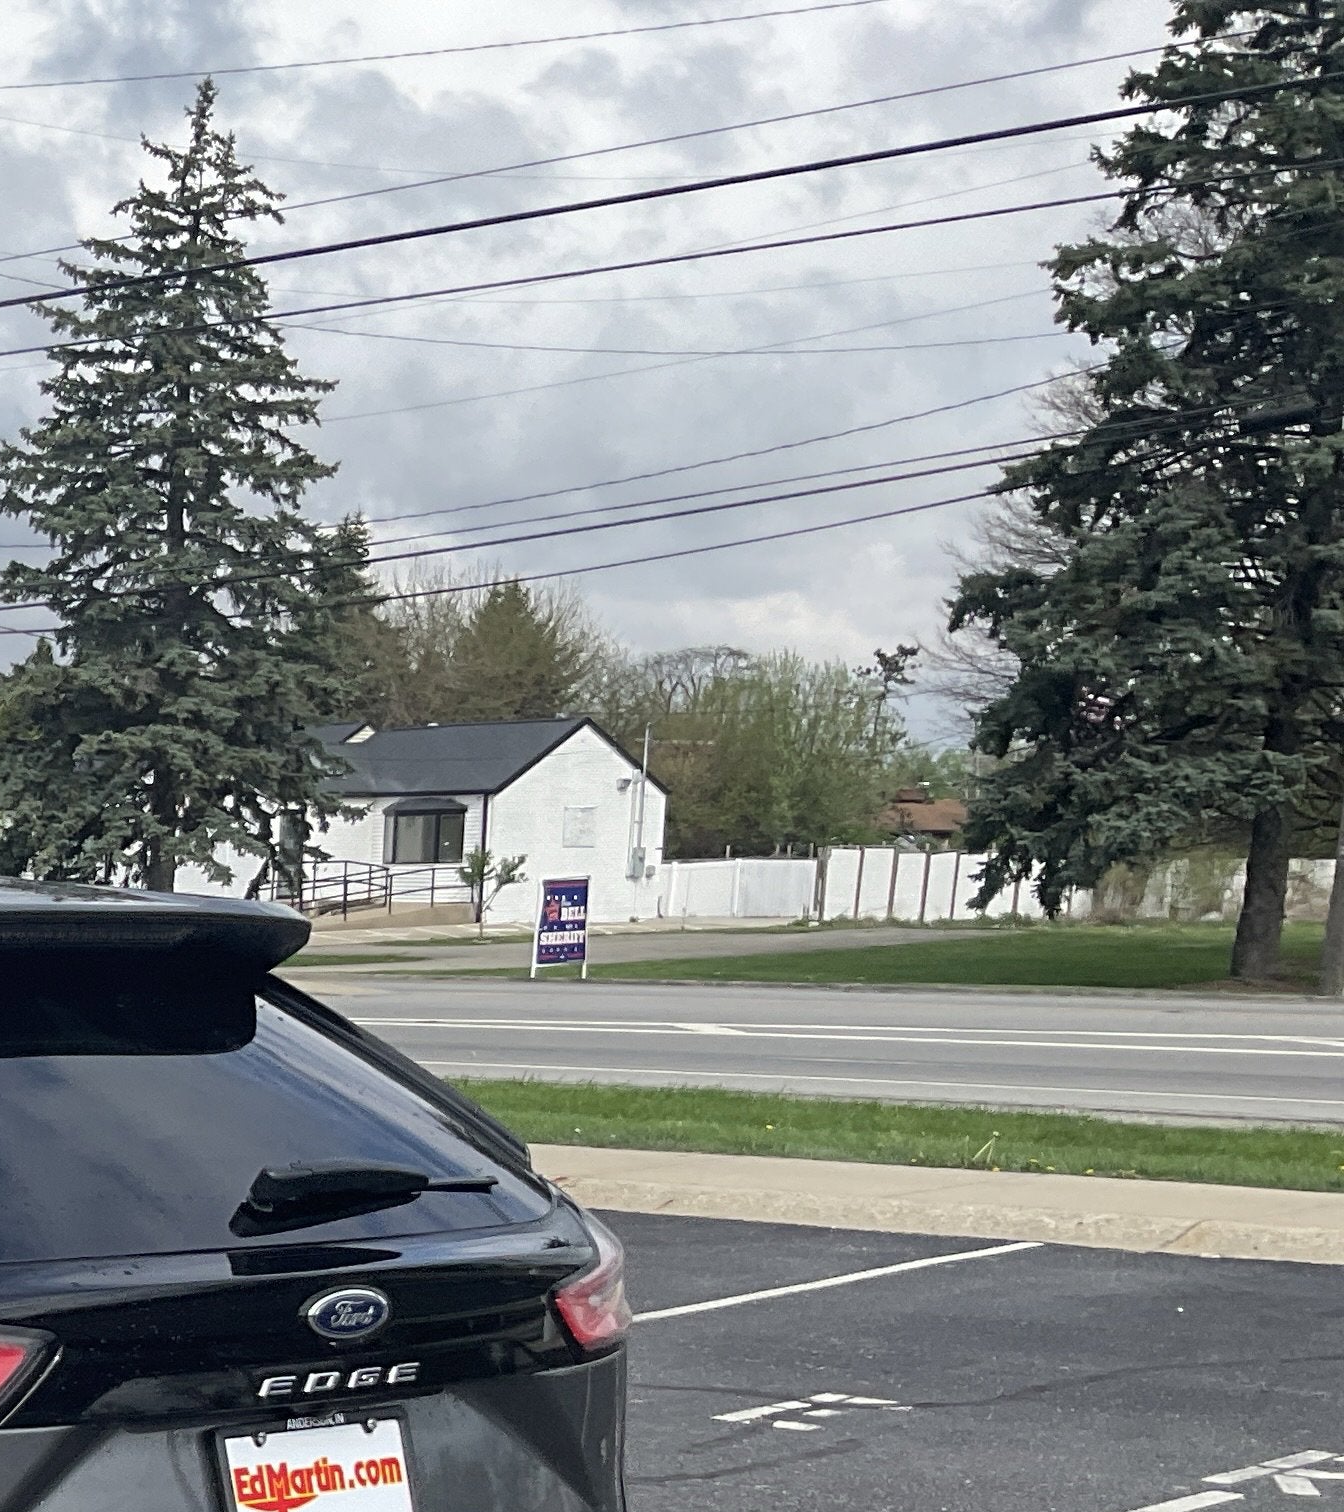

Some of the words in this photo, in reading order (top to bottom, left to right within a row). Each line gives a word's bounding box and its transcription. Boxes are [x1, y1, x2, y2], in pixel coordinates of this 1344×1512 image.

[561, 906, 585, 921] BELL
[330, 1300, 376, 1329] Ford
[258, 1361, 421, 1398] EDGE
[233, 1456, 403, 1504] EdMartin.com
